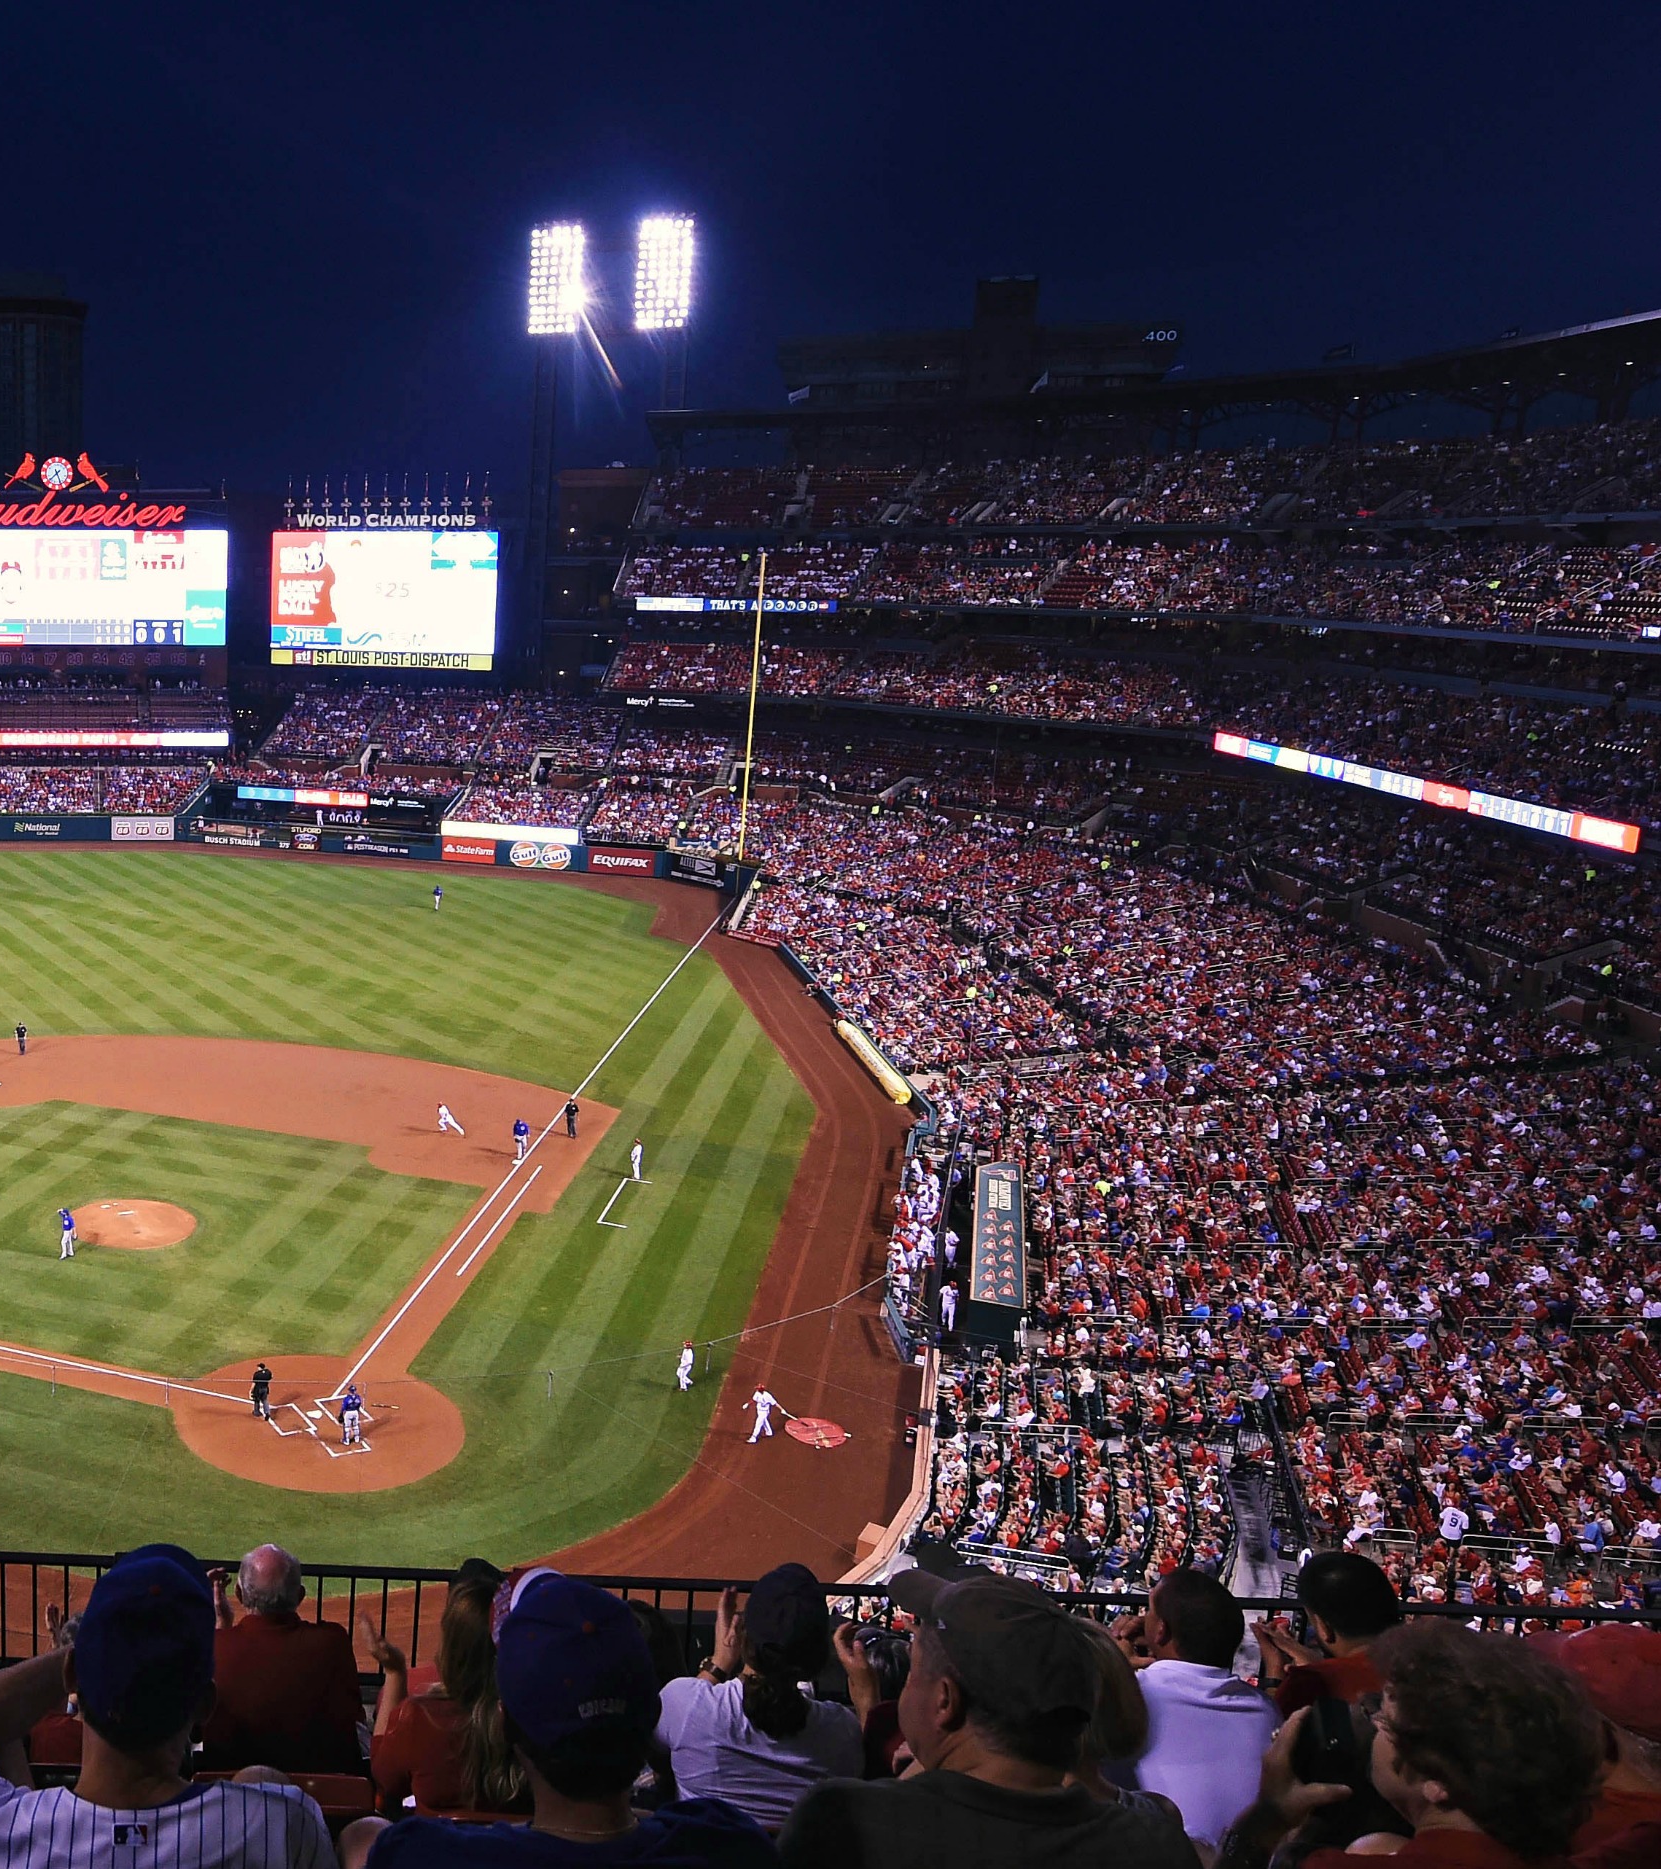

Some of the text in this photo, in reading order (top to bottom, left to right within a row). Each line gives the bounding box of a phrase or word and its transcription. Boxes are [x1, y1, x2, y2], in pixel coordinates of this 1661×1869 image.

[297, 513, 476, 527] WORLD CHAMPIONS
[709, 599, 746, 611] THAT'S
[750, 600, 760, 611] A
[316, 652, 469, 668] ST. LOUIS POST-DISPATCH
[626, 697, 650, 708] Mercy
[369, 797, 390, 807] Mercy
[24, 822, 61, 833] National
[117, 828, 129, 836] 66
[136, 828, 149, 836] 66
[155, 828, 169, 836] 66
[204, 835, 261, 847] BUSCH STADIUM
[511, 849, 538, 861] Gulf
[541, 851, 568, 863] Gulf
[592, 854, 651, 869] EQUIFAX
[1449, 1517, 1459, 1528] 9
